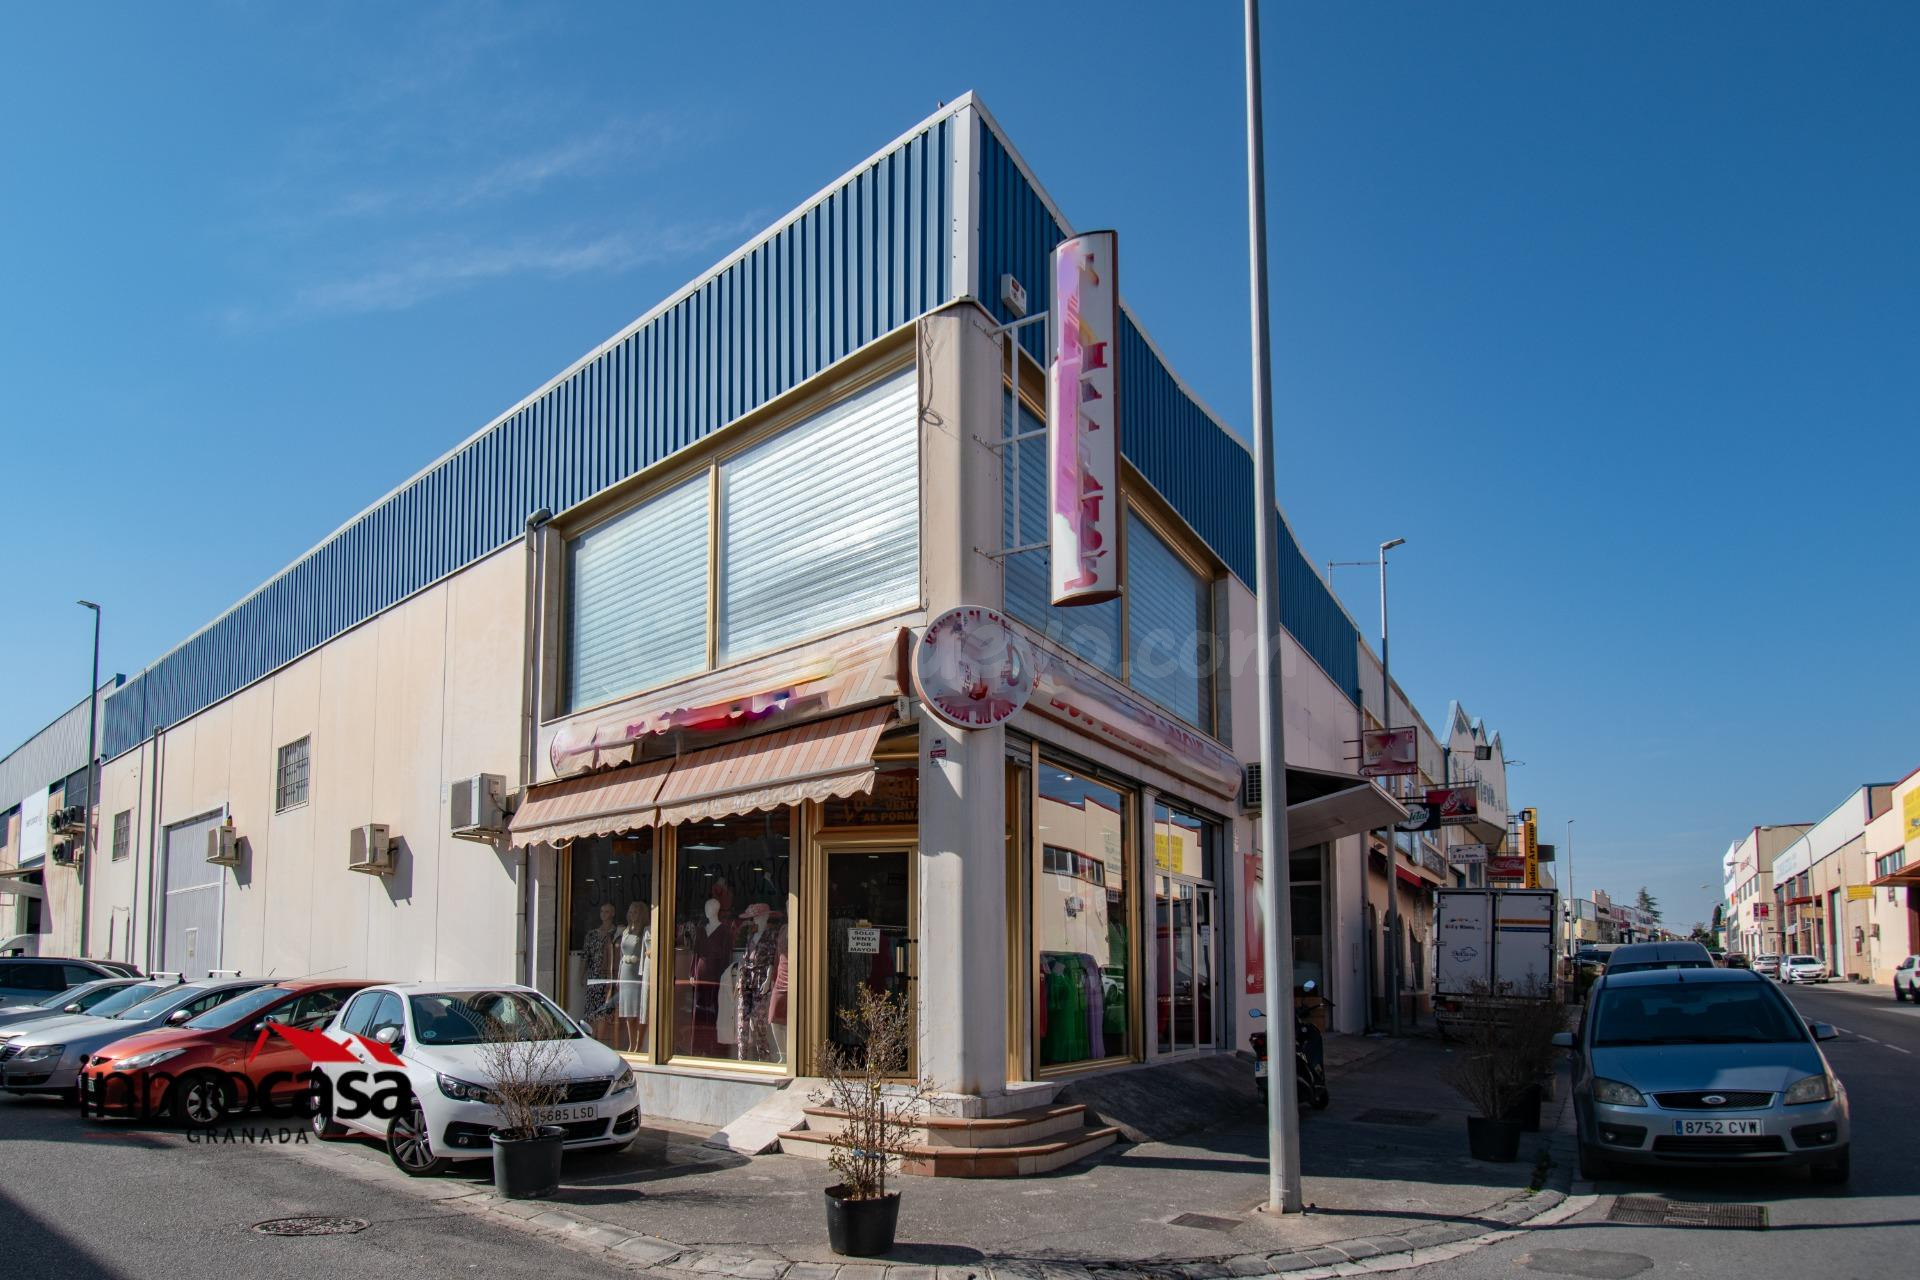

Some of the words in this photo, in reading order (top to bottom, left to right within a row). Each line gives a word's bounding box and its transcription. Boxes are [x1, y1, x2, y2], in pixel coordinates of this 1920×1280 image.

[886, 800, 918, 809] VENT
[573, 1106, 594, 1119] LSD
[1685, 1121, 1723, 1134] 8752
[1728, 1121, 1757, 1133] CVW
